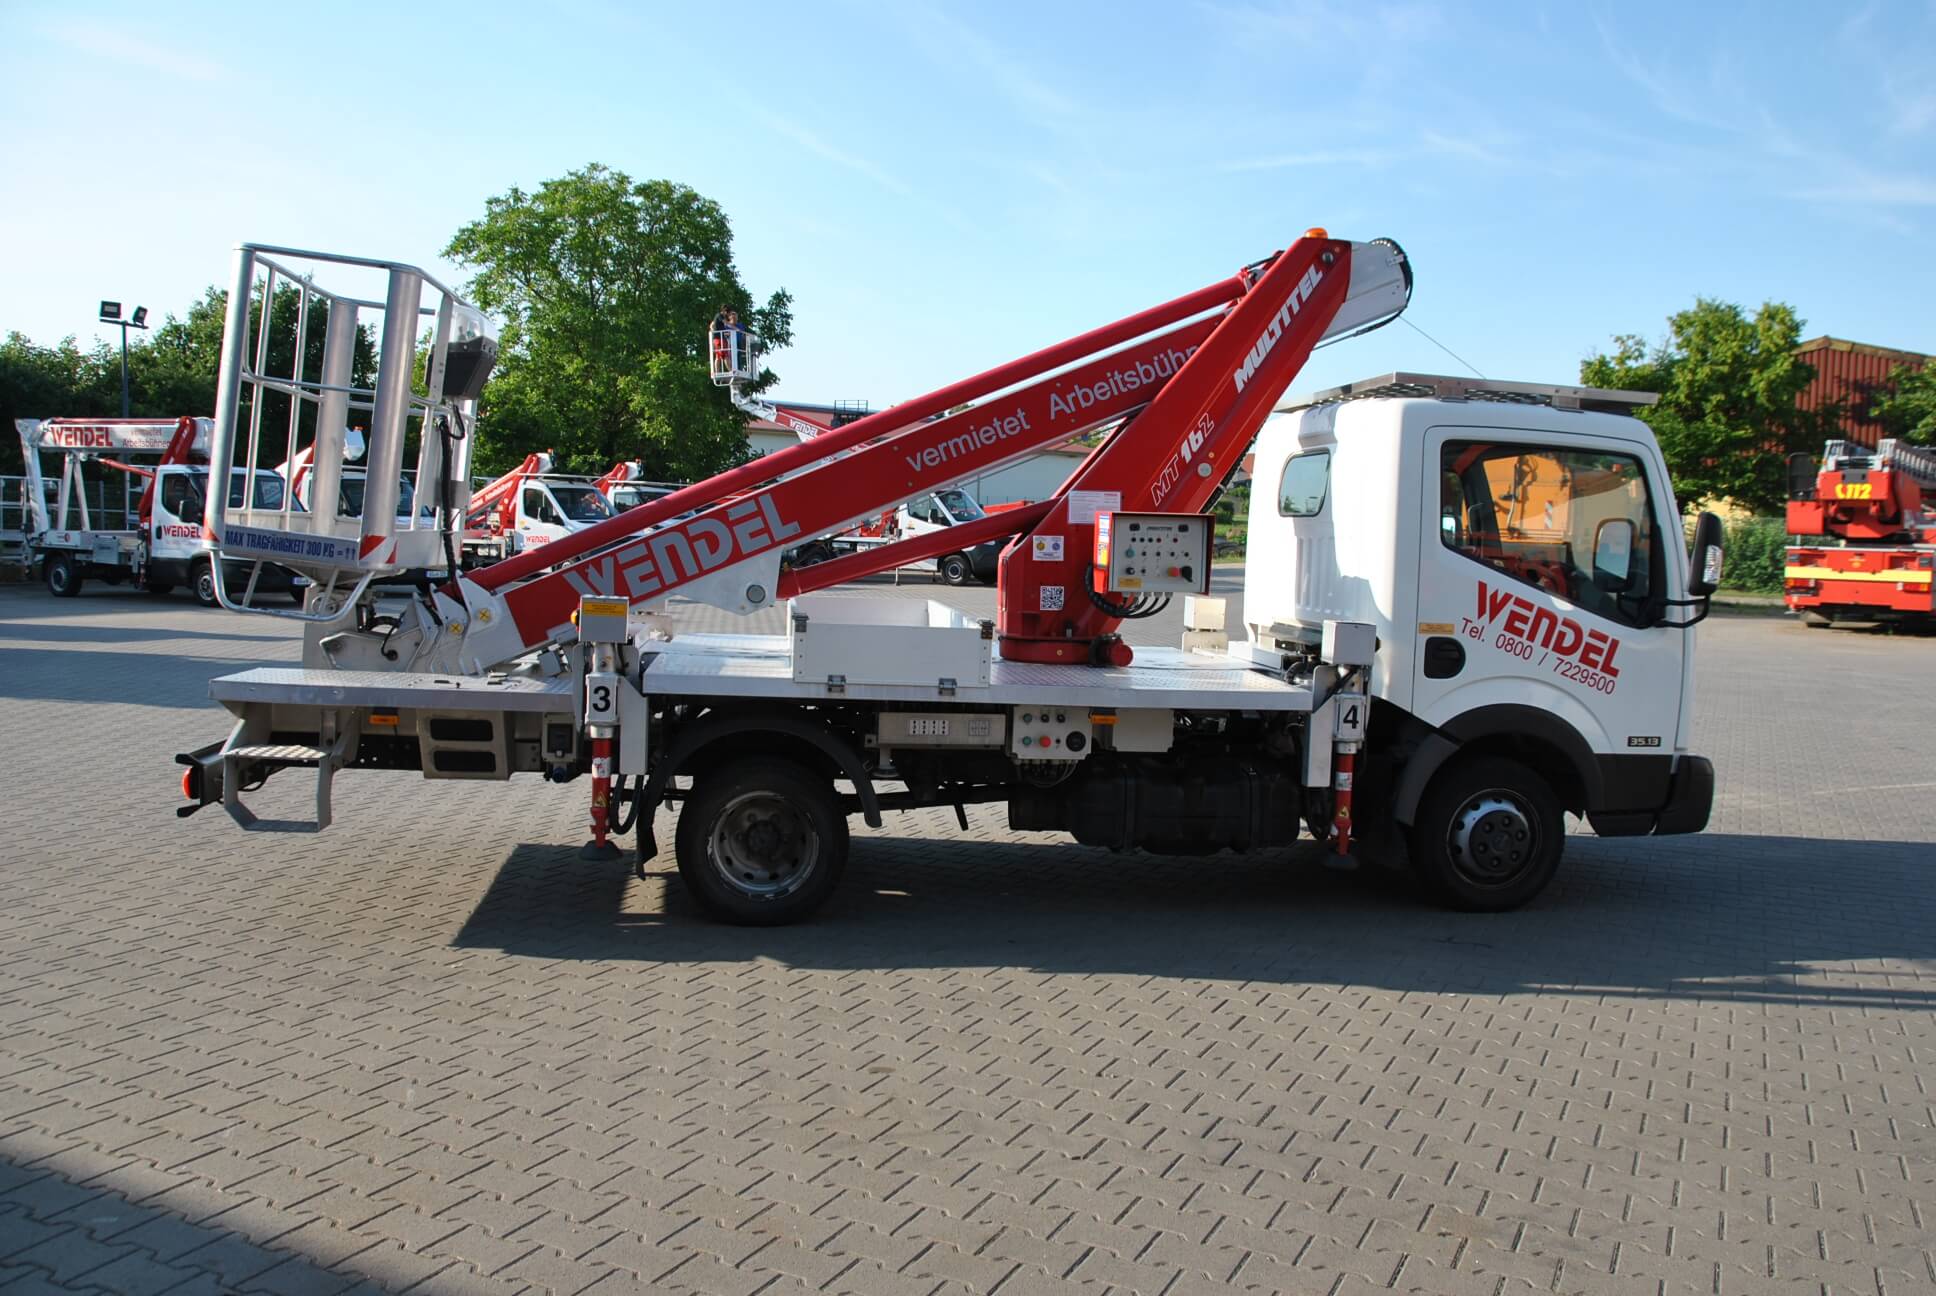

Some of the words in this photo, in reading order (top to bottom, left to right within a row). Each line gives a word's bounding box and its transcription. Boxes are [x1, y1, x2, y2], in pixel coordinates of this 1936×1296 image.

[1233, 263, 1324, 394] MULTITEL
[51, 427, 113, 447] WENDEL
[789, 419, 818, 438] WENDEL
[906, 407, 1031, 473] vermietet
[1151, 453, 1179, 507] MT
[1847, 484, 1873, 499] 112
[163, 525, 201, 538] WENDEL
[225, 530, 244, 546] MAX
[246, 533, 305, 554] TRAGFÄHIGKEIT
[307, 541, 320, 556] 300
[561, 494, 800, 599] WENDEL
[1477, 580, 1621, 678] WENDEL
[1461, 618, 1485, 642] Tel.
[1496, 633, 1533, 660] 0800
[1538, 652, 1548, 666] /
[1553, 657, 1616, 695] 7229500
[592, 686, 611, 712] 3
[1343, 704, 1359, 729] 4
